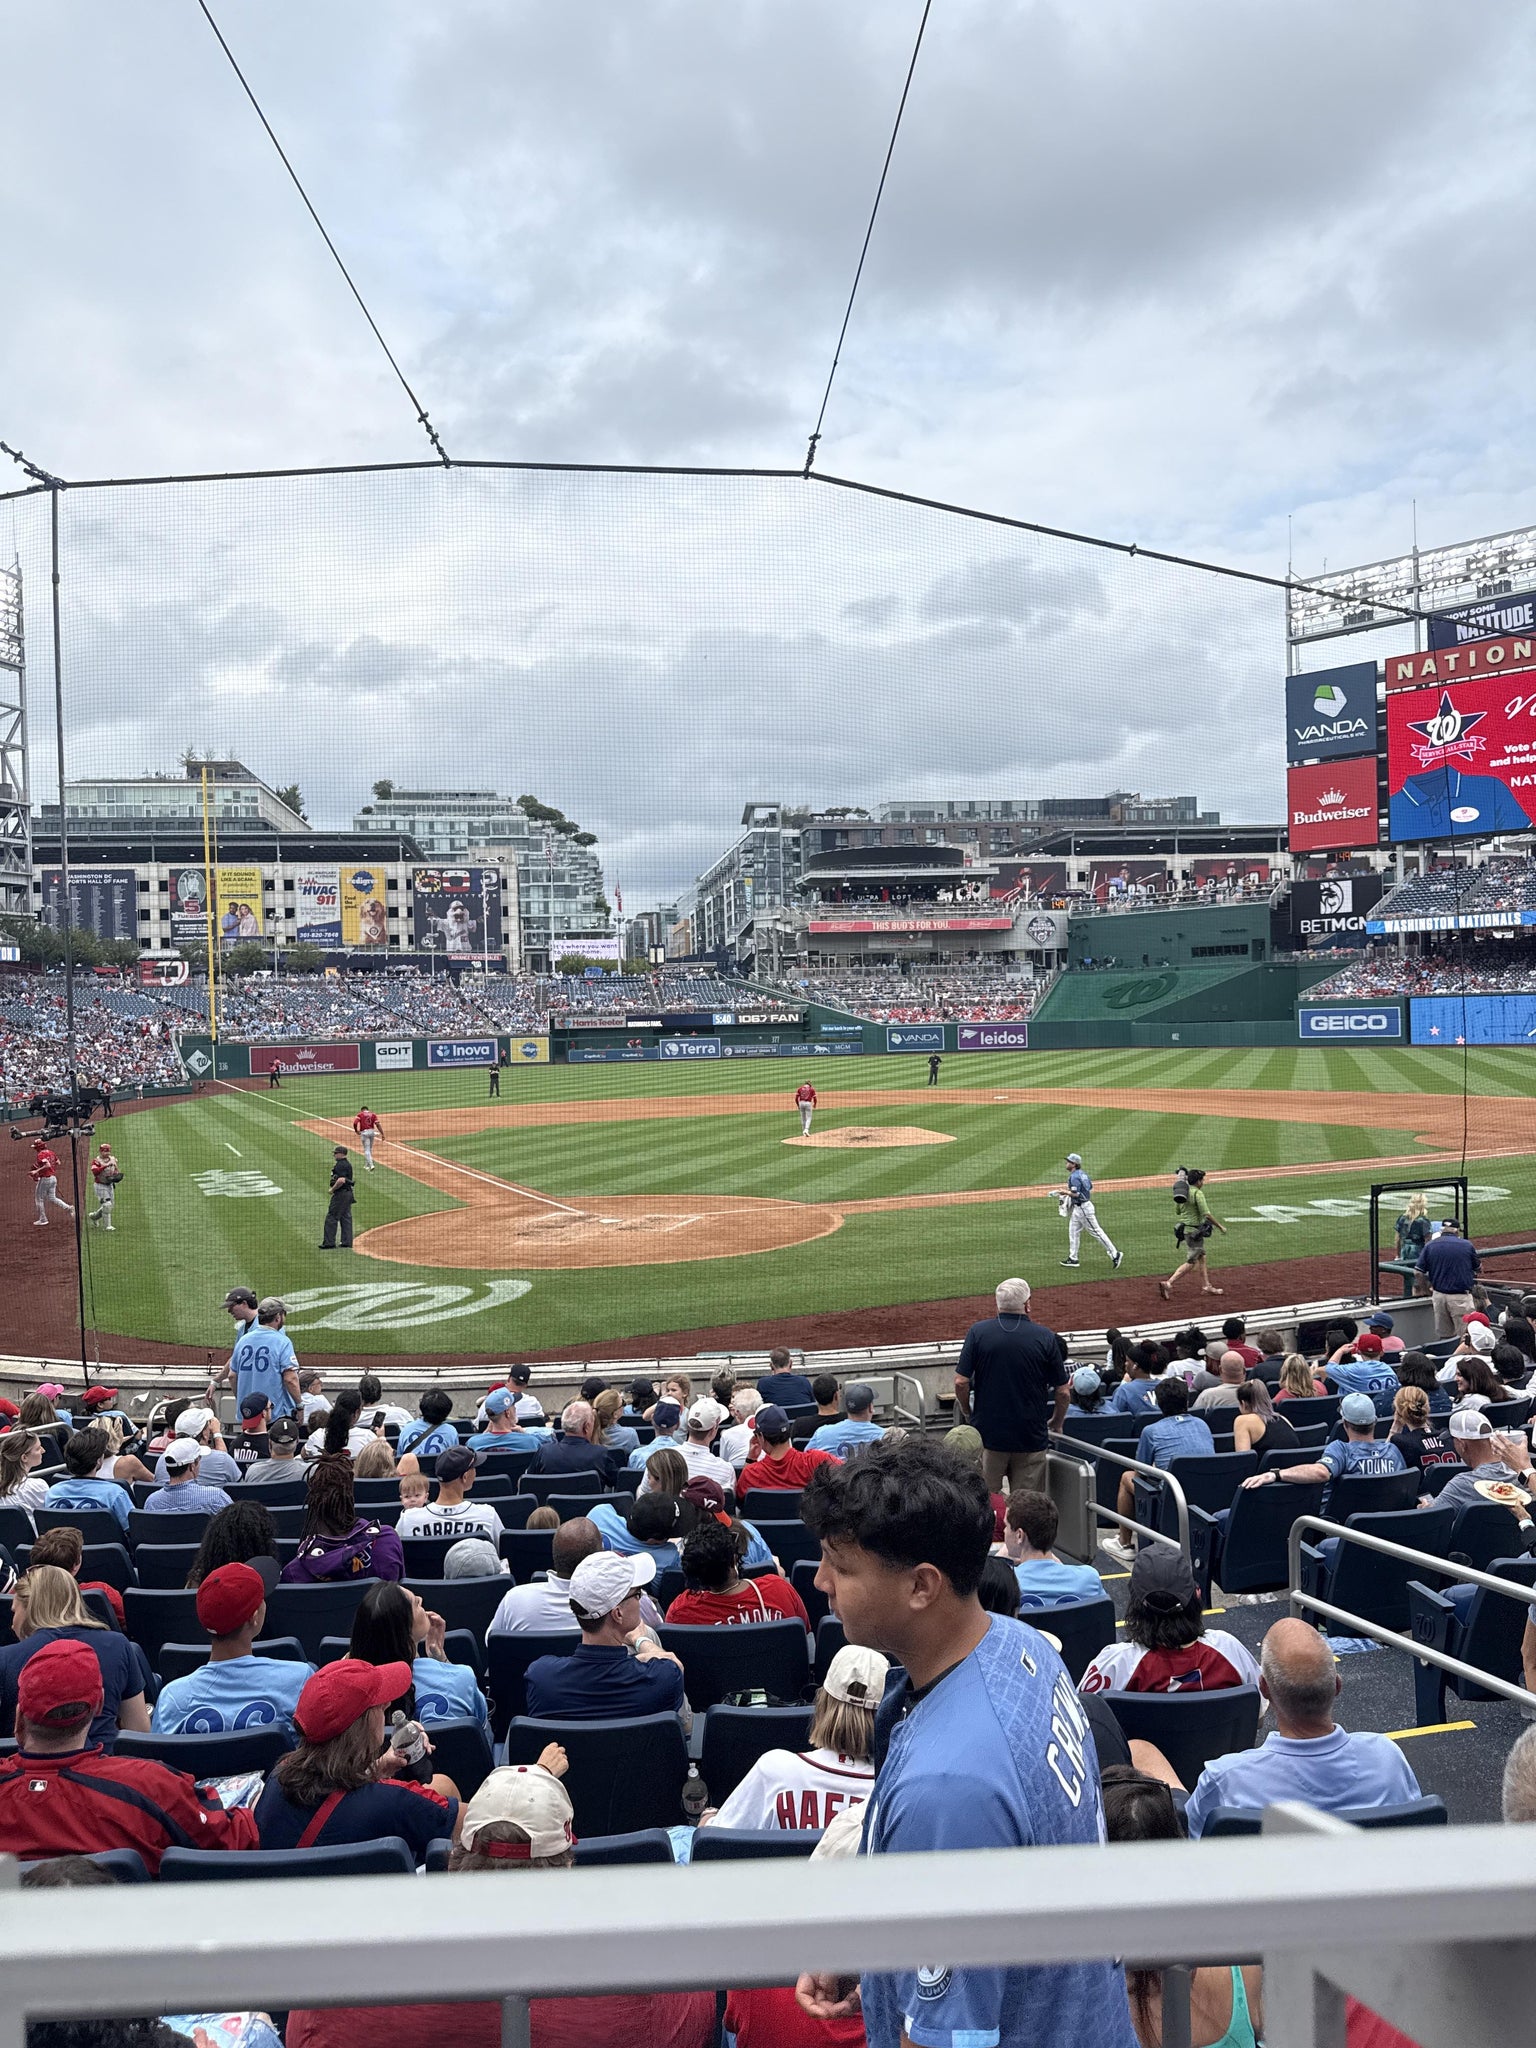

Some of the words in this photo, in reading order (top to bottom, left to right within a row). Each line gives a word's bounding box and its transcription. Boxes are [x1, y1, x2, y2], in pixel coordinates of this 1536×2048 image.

[1443, 609, 1468, 620] HOW
[1469, 603, 1496, 616] SOME
[1456, 602, 1534, 641] NATITUDE
[1294, 718, 1369, 740] VANDA
[1446, 742, 1474, 753] ALL-STAR
[1504, 745, 1529, 754] Vote
[1490, 757, 1511, 767] and
[1293, 807, 1371, 825] Budweiser
[302, 885, 338, 895] HVAC
[316, 895, 336, 905] 911
[872, 921, 890, 930] THIS
[891, 921, 914, 930] BUD'S
[916, 920, 931, 929] FOR
[933, 920, 950, 929] YOU.
[1384, 915, 1455, 933] WASHINGTON
[1458, 911, 1521, 929] NATIONALS
[573, 1019, 597, 1027] Harris
[715, 1014, 732, 1024] 5:40
[771, 1013, 799, 1022] FAN
[1310, 1014, 1388, 1031] GEICO
[902, 1033, 940, 1042] VANDA
[981, 1031, 1025, 1045] leidos
[377, 1046, 411, 1055] GDIT
[453, 1044, 490, 1056] Inova
[680, 1043, 716, 1054] Terra
[278, 1061, 334, 1072] Budweiser
[240, 1345, 270, 1372] 26
[1422, 1437, 1445, 1450] RUIZ
[1358, 1459, 1395, 1475] YOUNG
[704, 1498, 718, 1508] VT
